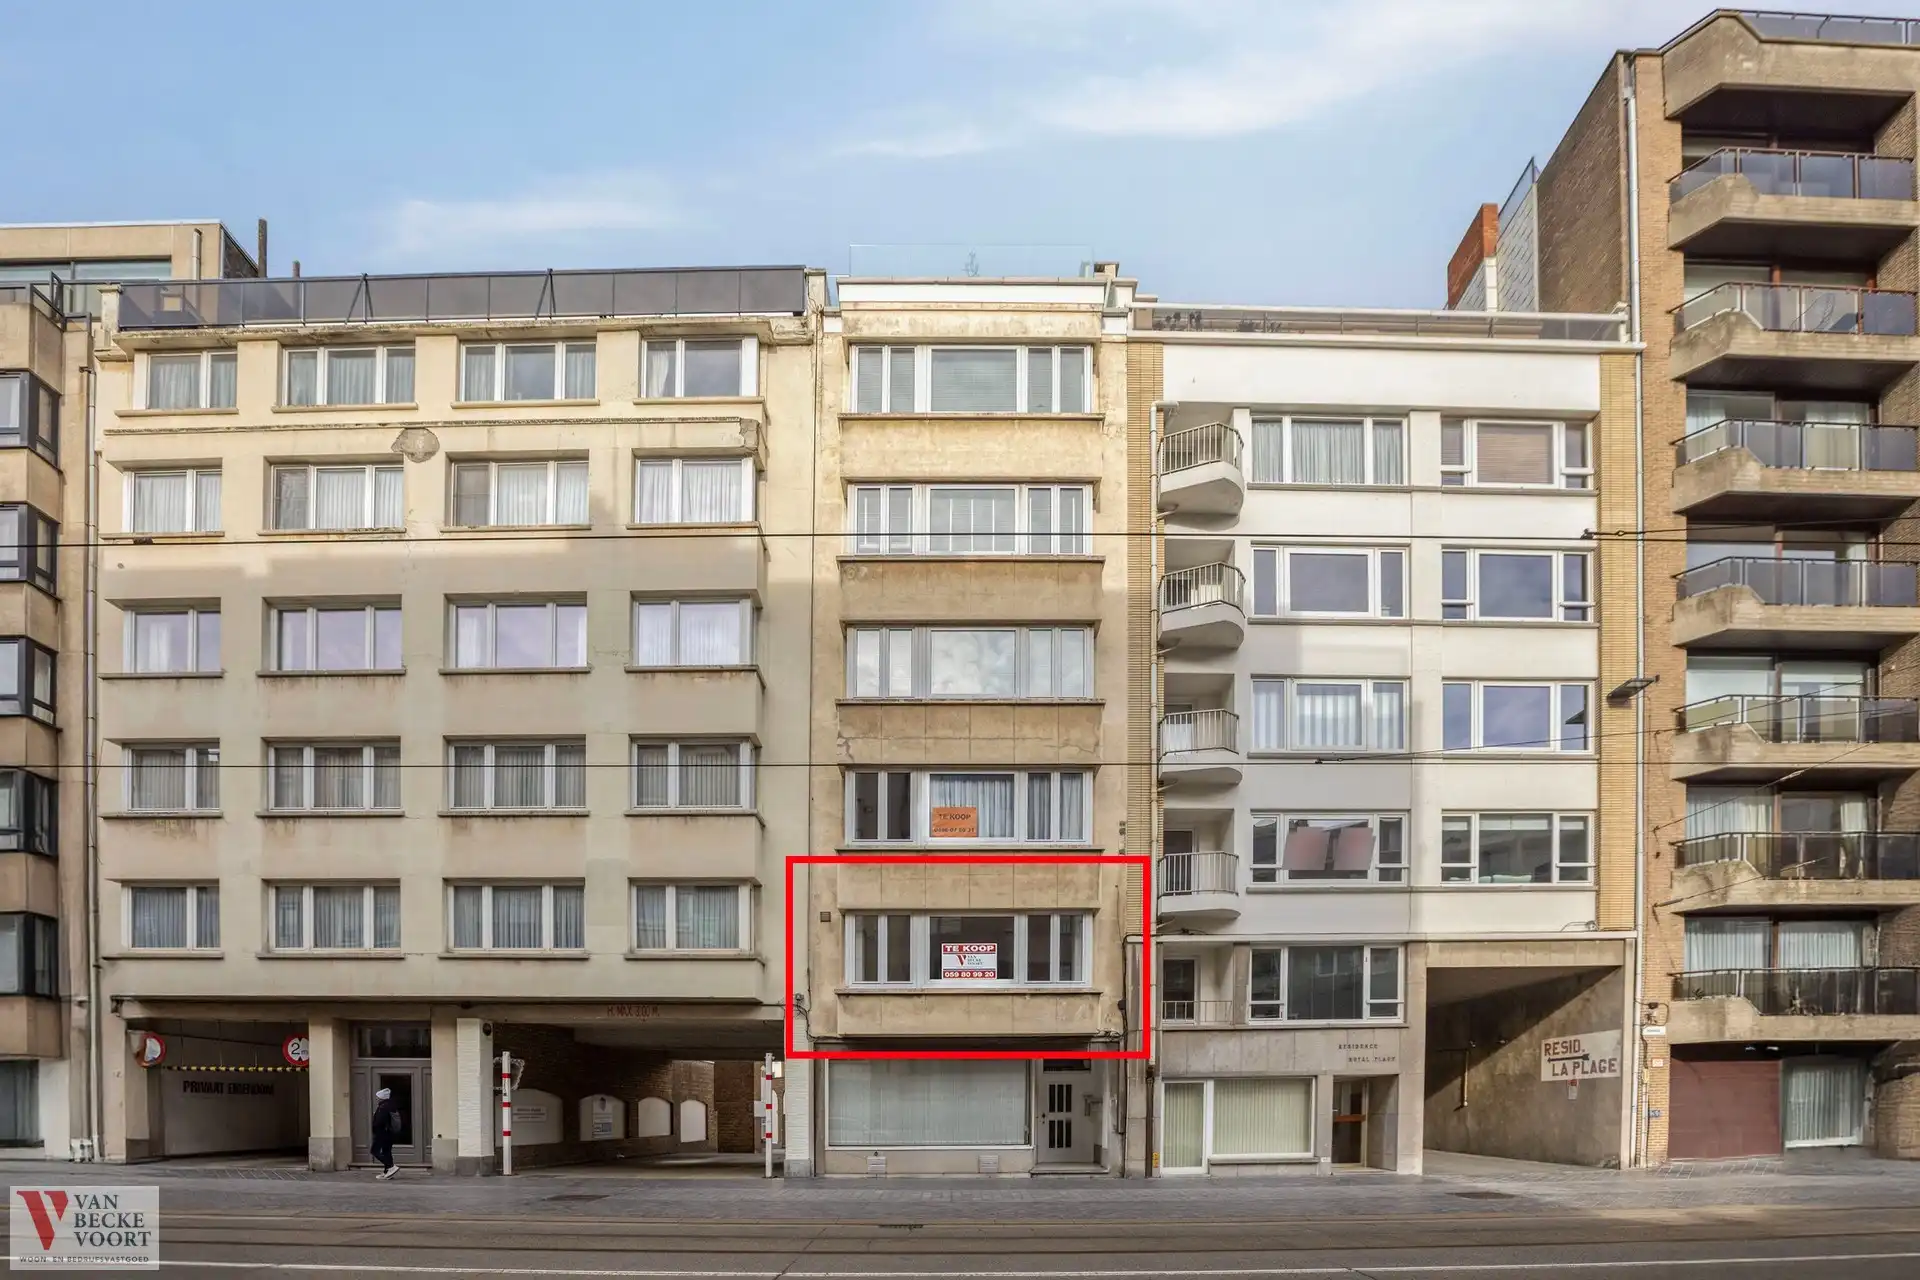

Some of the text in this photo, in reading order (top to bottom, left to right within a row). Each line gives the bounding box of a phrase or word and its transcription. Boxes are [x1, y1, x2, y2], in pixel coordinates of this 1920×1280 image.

[291, 1042, 300, 1055] 2
[1544, 1038, 1585, 1056] RESID.
[1552, 1058, 1617, 1076] LA PLAGE
[183, 1080, 224, 1093] PRIVAAT
